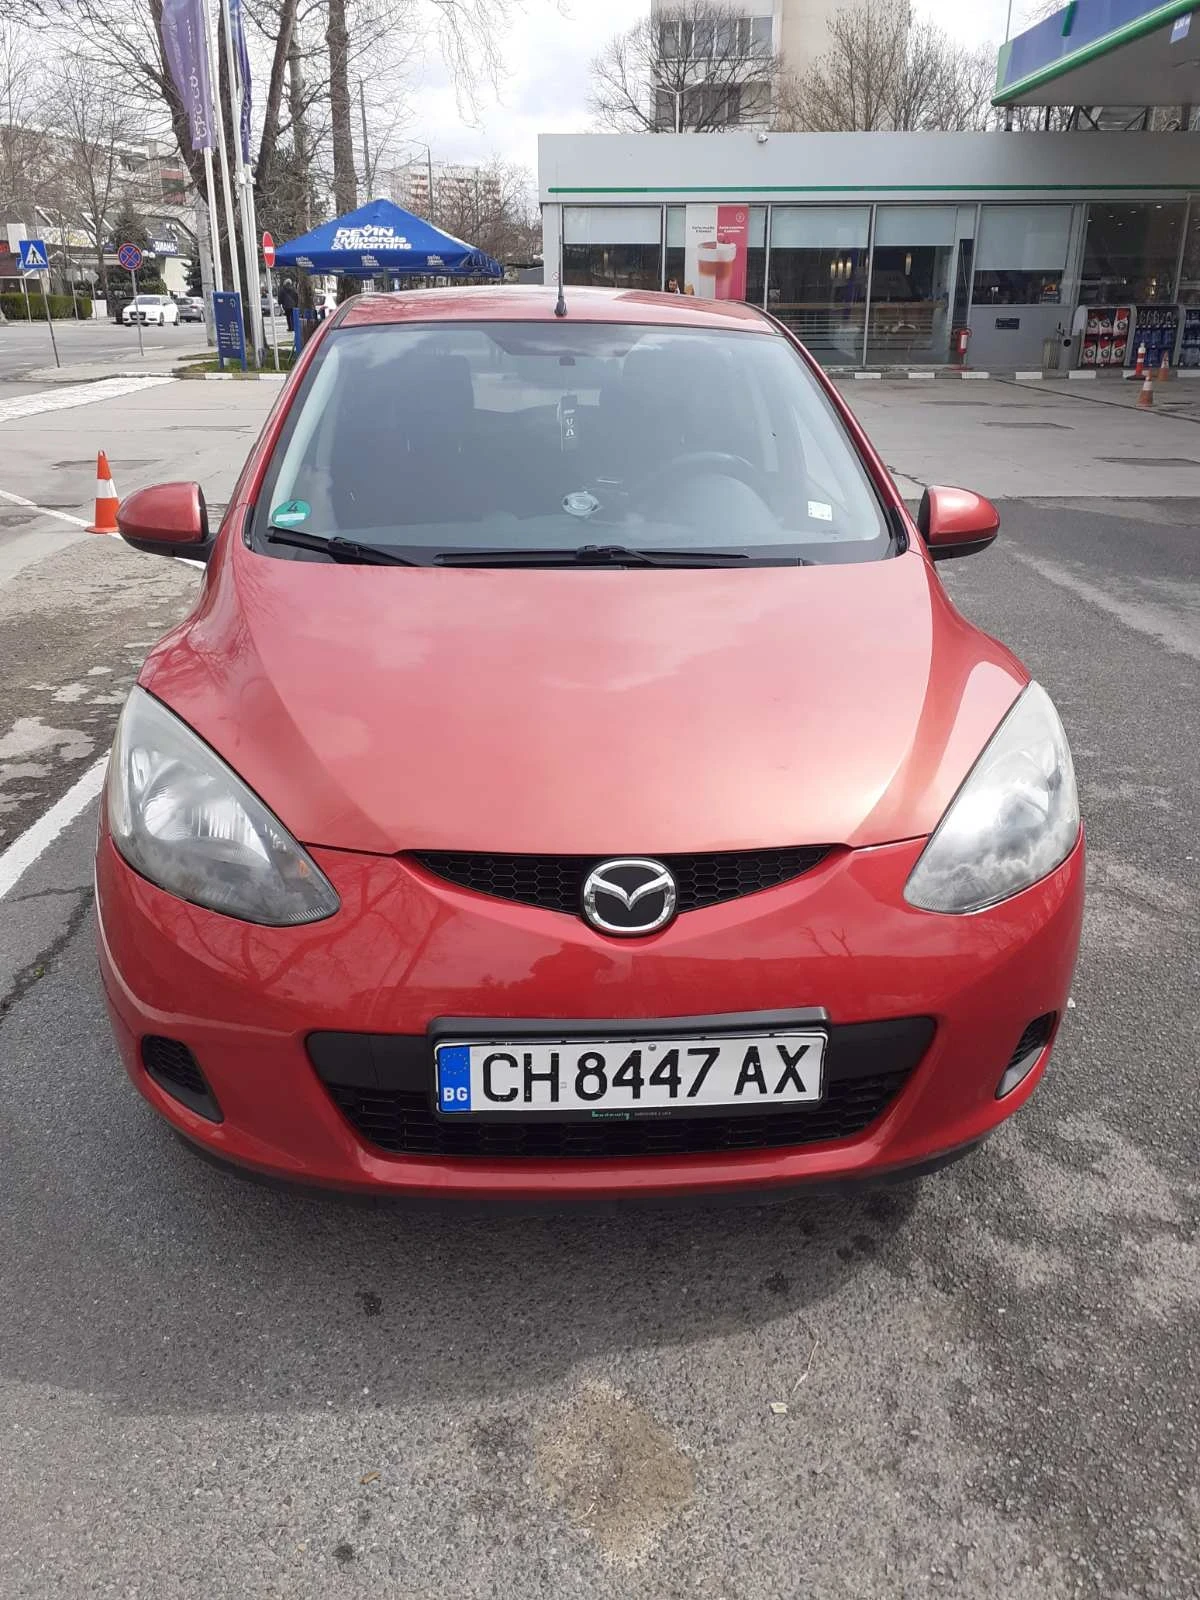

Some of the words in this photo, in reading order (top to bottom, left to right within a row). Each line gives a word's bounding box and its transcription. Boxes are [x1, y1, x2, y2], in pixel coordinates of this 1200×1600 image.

[335, 227, 394, 237] DEVIN
[287, 502, 299, 513] 4
[482, 1052, 559, 1103] CH
[574, 1047, 721, 1102] 8447
[733, 1044, 811, 1096] AX
[443, 1087, 468, 1102] BG
